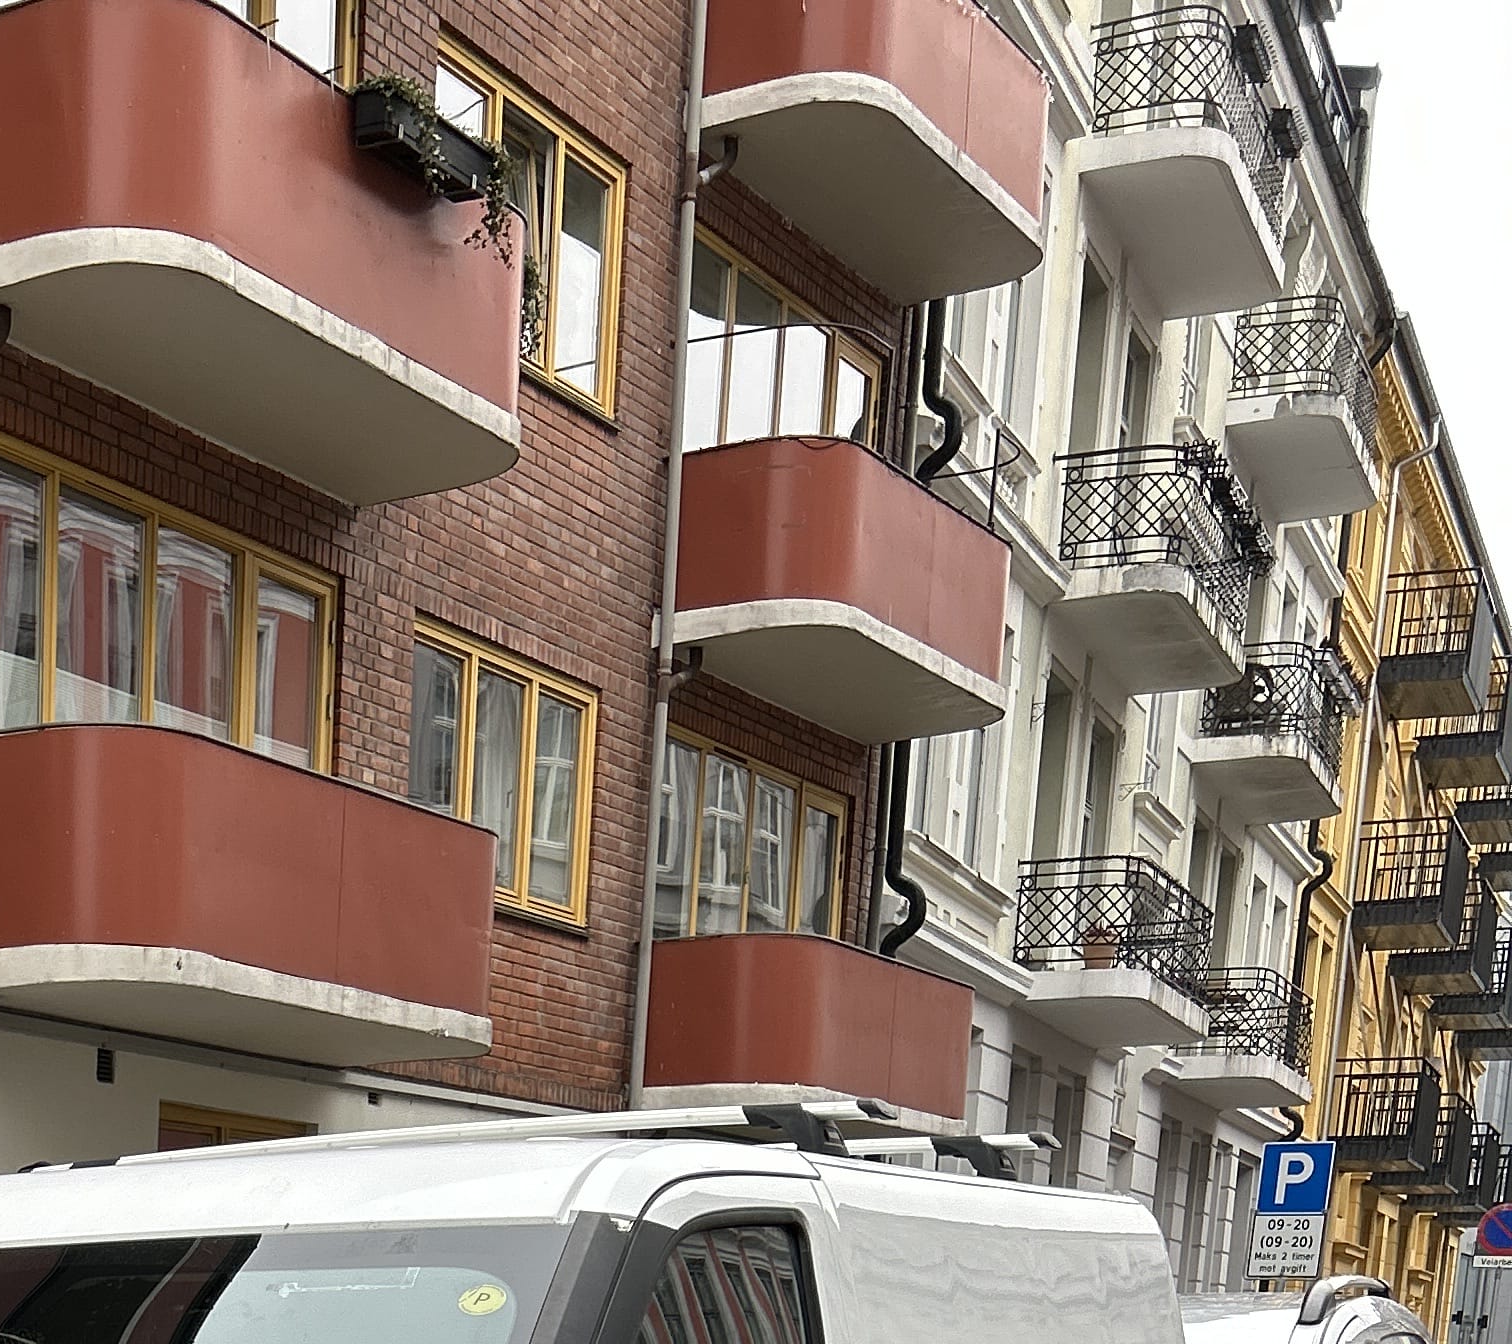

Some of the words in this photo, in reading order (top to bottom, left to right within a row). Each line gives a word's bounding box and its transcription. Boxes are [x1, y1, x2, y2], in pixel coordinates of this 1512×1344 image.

[1275, 1152, 1314, 1204] P
[1254, 1252, 1277, 1261] Maks
[1281, 1251, 1288, 1261] 2
[1259, 1264, 1276, 1273] mot
[1280, 1263, 1307, 1275] avgift
[473, 1292, 491, 1306] P
